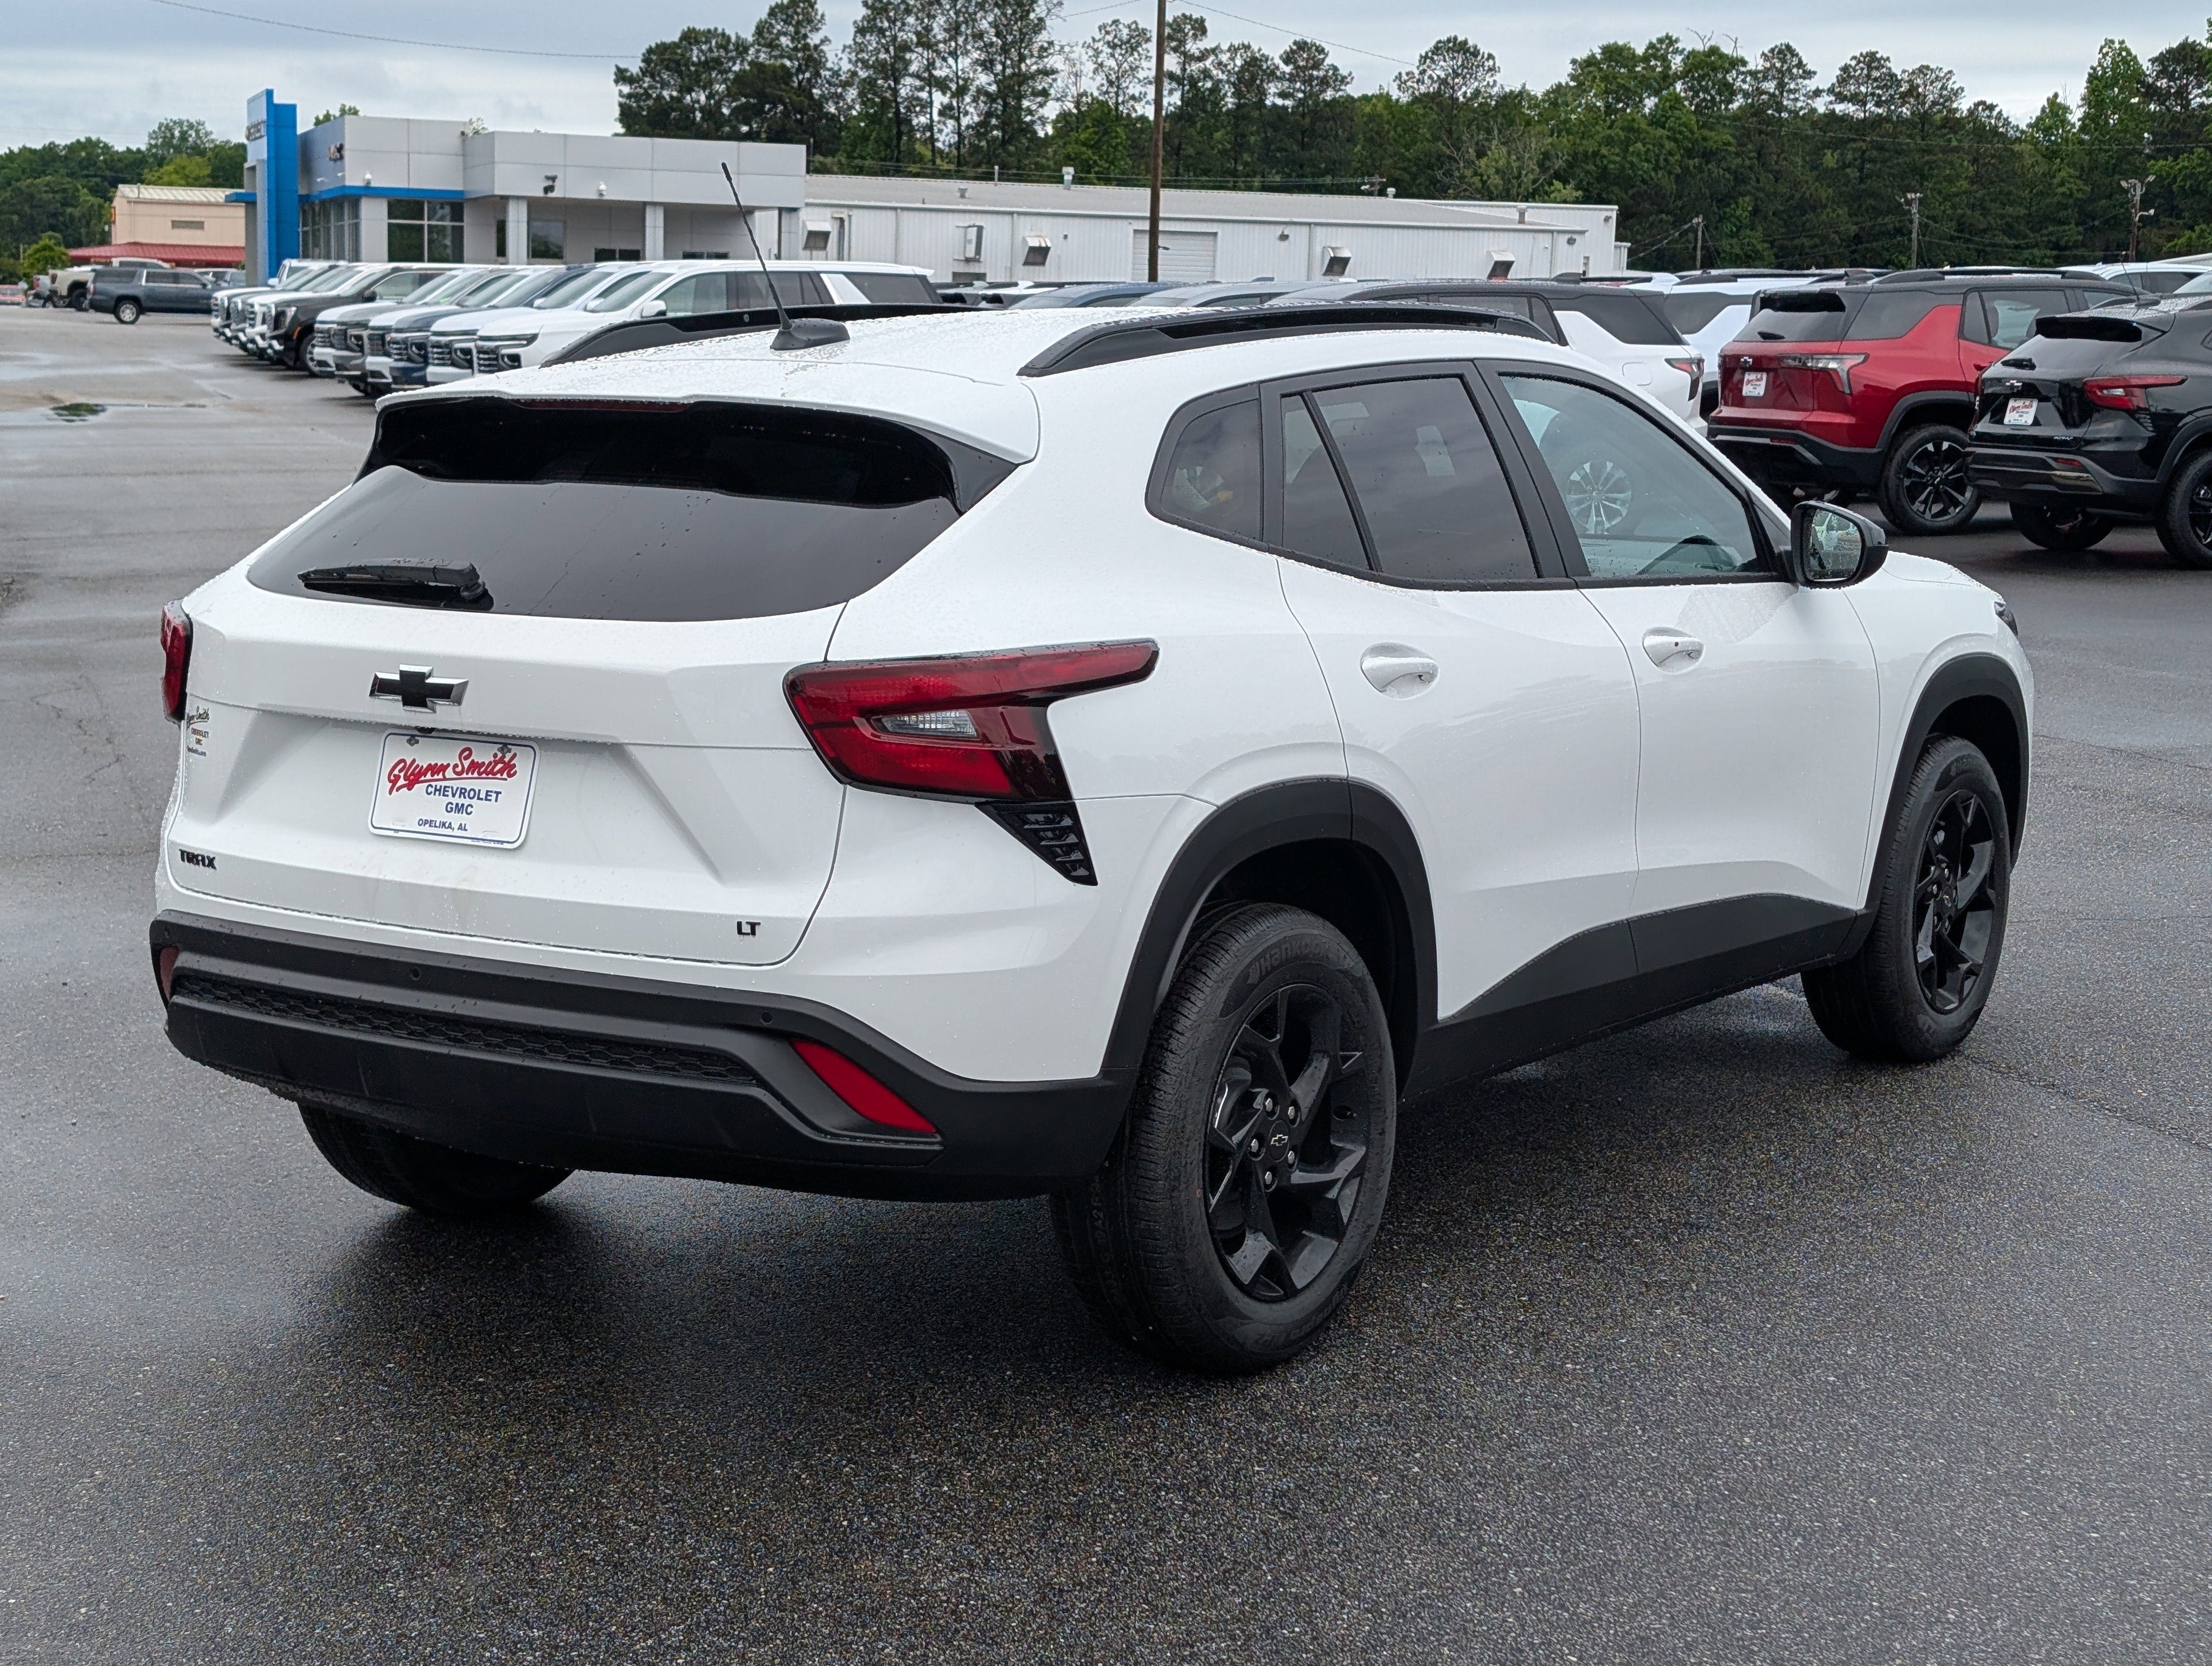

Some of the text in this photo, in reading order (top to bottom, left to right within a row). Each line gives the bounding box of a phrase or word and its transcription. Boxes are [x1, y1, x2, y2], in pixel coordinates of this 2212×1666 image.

[387, 747, 517, 796] Glynn Smith
[425, 784, 502, 803] CHEVROLET
[445, 801, 473, 816] GMC
[417, 818, 468, 831] OPELIKA, AL
[178, 849, 217, 870] TRAX
[737, 921, 761, 936] LT
